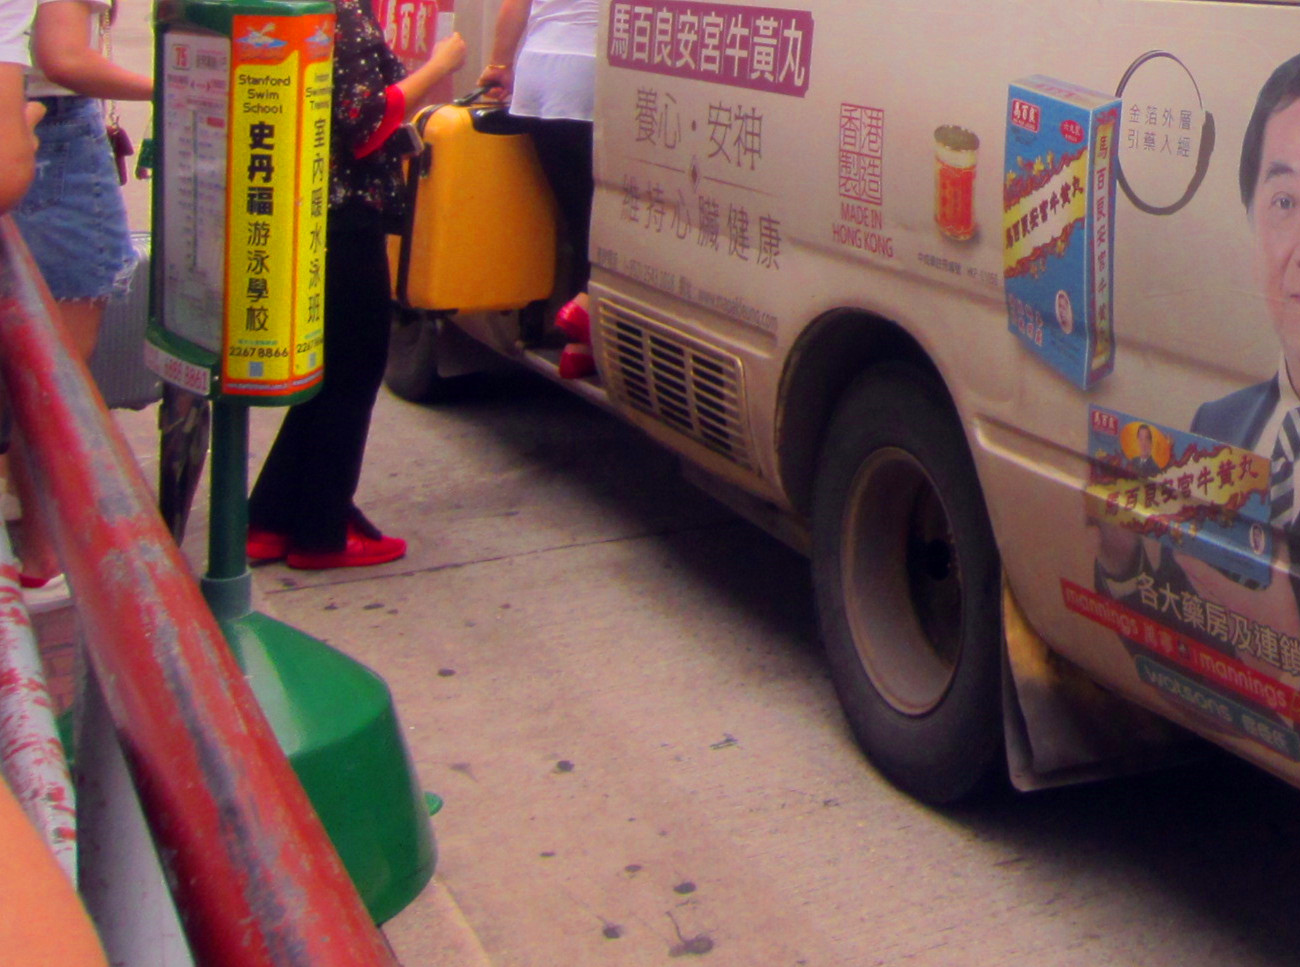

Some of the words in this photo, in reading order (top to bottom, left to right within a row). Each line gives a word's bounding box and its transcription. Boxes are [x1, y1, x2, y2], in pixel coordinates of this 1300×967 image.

[610, 3, 806, 87] 馬百良安宮牛黃丸
[238, 74, 291, 87] Stanford
[247, 89, 279, 100] Swim
[242, 103, 283, 114] School
[245, 121, 274, 332] 史丹福游泳學校
[841, 202, 870, 227] MADE
[870, 209, 882, 230] IN
[832, 223, 862, 249] HONG
[863, 233, 895, 258] KONG
[228, 346, 254, 357] 2267
[257, 347, 289, 358] 8866
[1198, 650, 1287, 708] mannings
